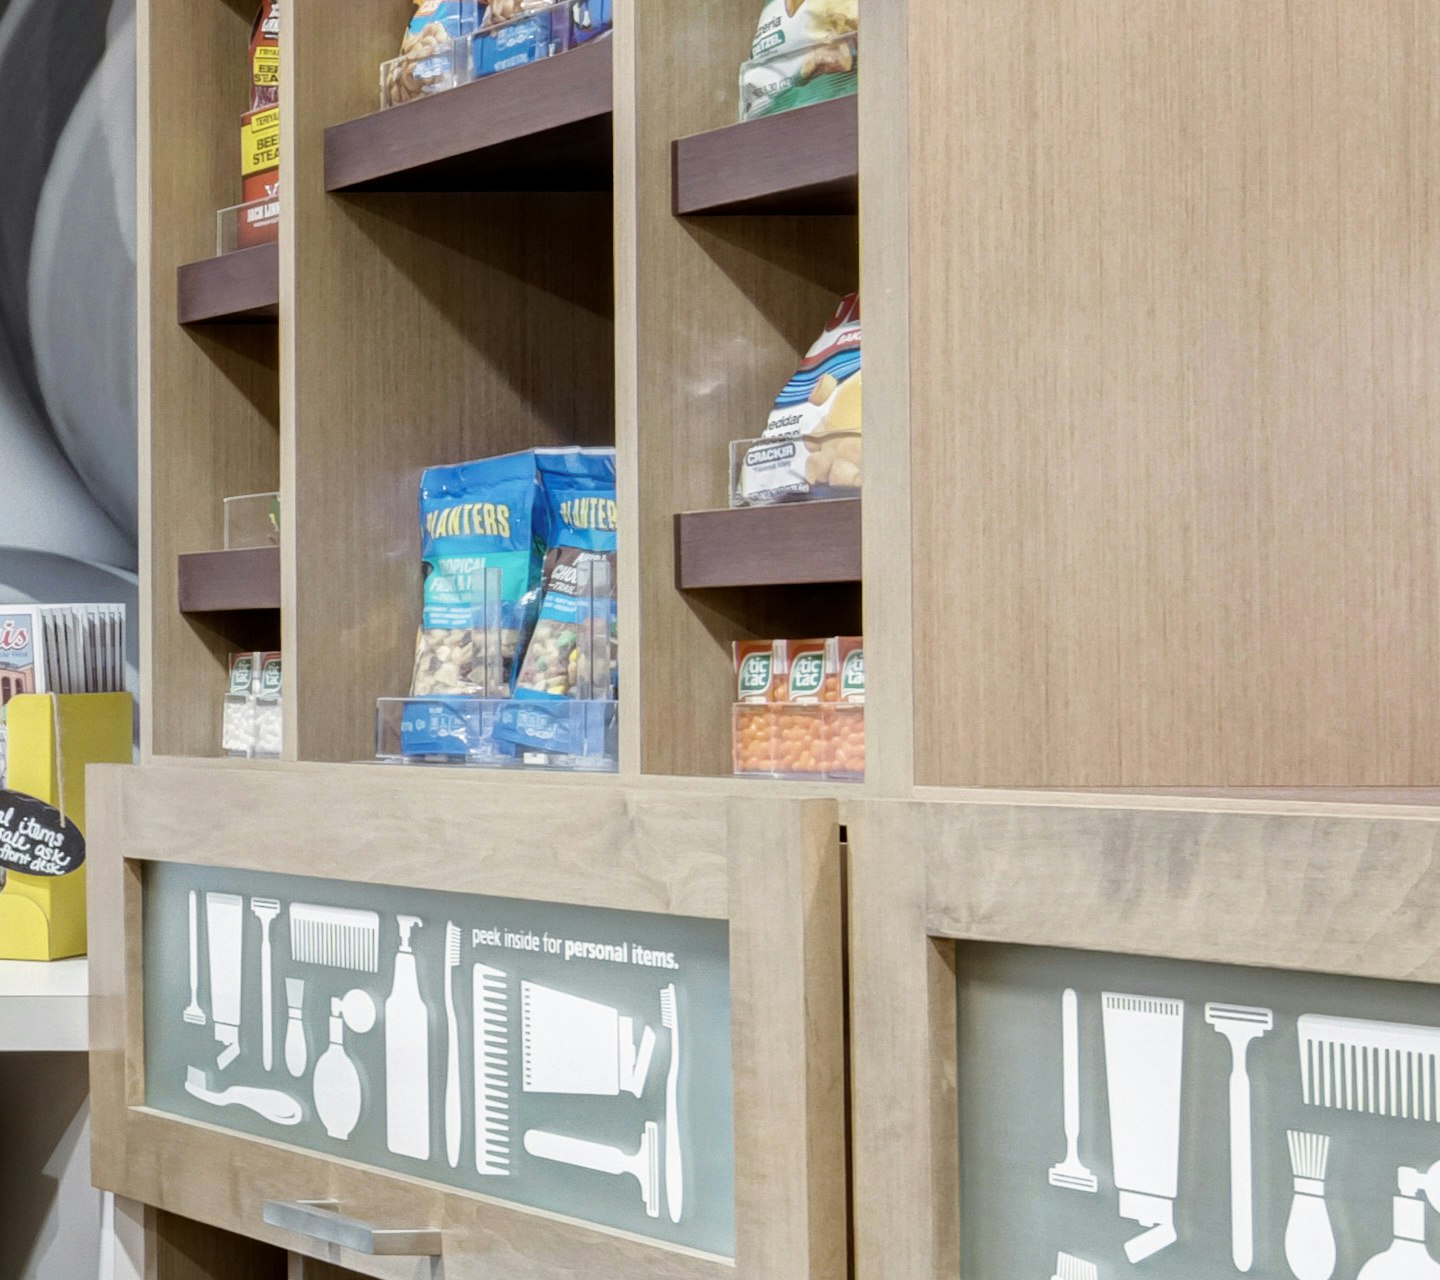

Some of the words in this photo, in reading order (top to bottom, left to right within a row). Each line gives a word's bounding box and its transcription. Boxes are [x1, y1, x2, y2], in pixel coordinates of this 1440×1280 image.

[768, 414, 804, 432] eddar
[747, 444, 794, 464] CRACKER
[749, 655, 767, 672] tic
[800, 655, 820, 672] tic
[742, 670, 767, 687] tac
[793, 670, 819, 687] tac
[19, 817, 65, 848] items
[0, 843, 31, 865] front
[30, 859, 65, 876] desk
[34, 845, 71, 867] ask
[472, 927, 501, 948] peek
[504, 928, 540, 952] inside
[542, 932, 562, 954] for
[565, 940, 628, 963] personal
[631, 943, 679, 969] items.
